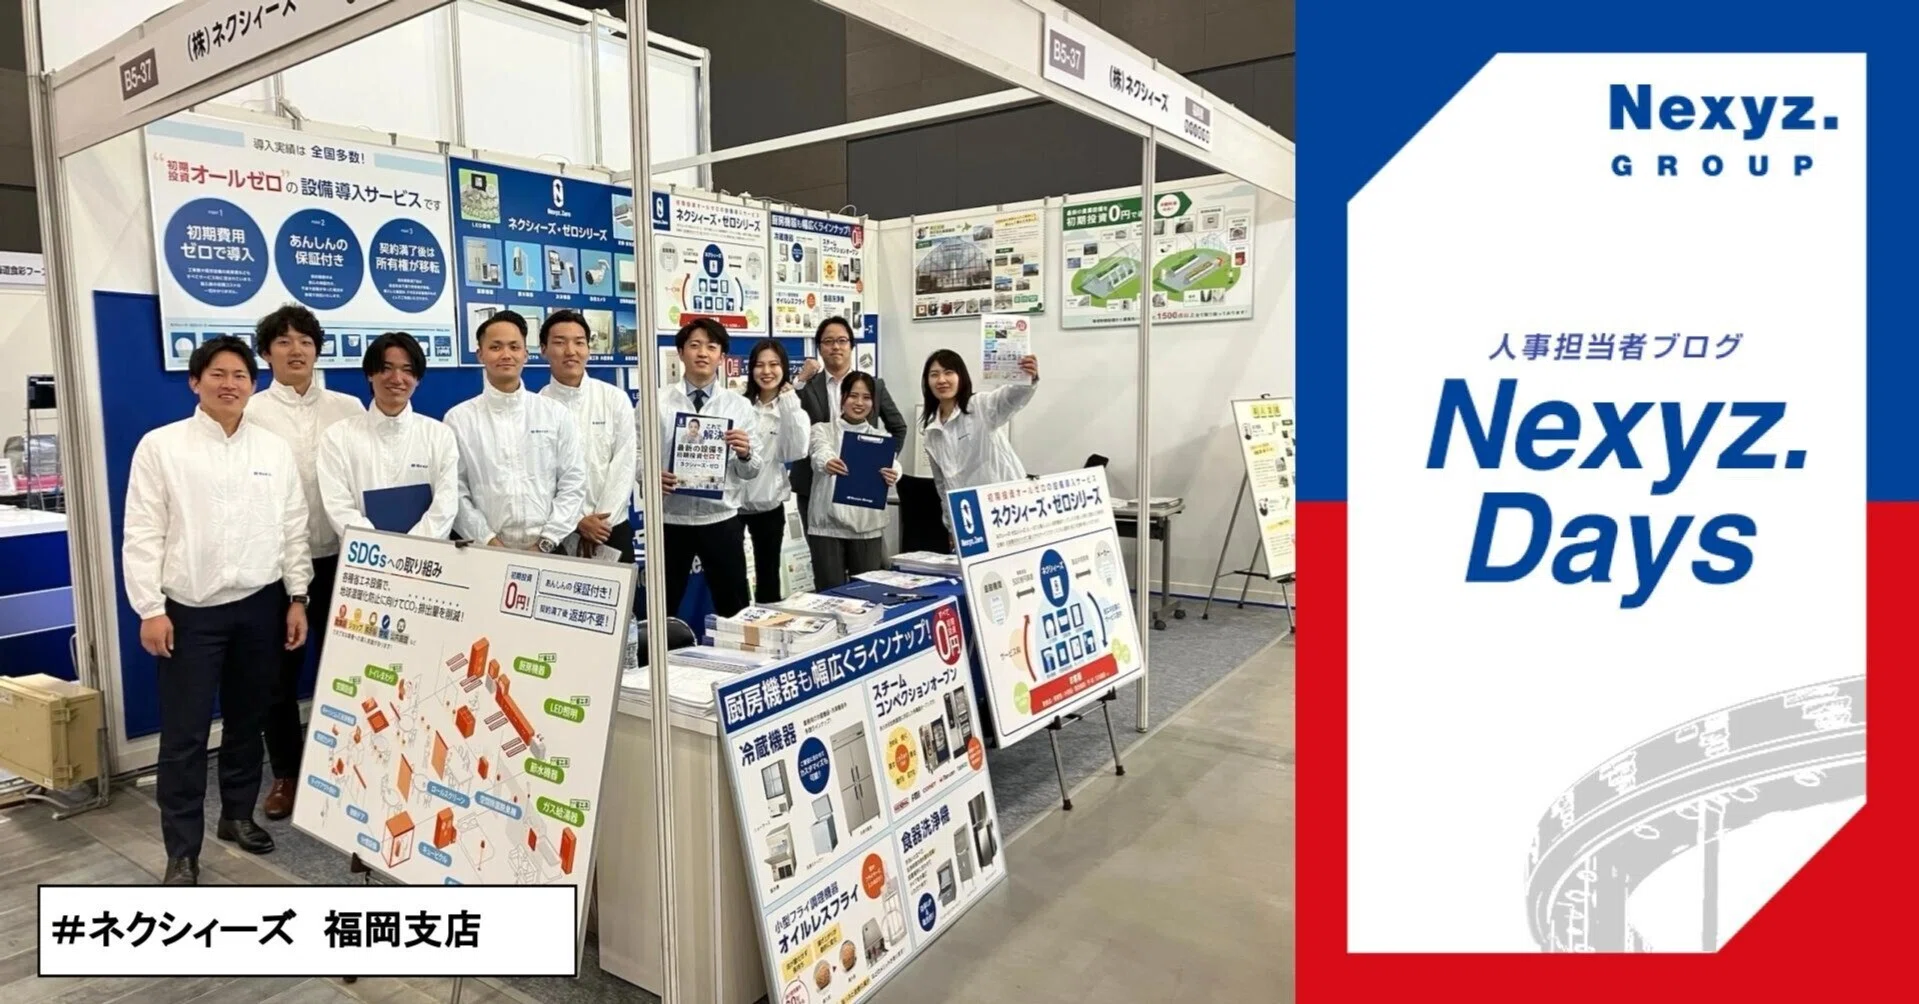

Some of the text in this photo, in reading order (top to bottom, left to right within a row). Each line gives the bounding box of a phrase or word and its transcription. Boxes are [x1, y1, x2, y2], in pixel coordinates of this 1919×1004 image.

[1053, 40, 1082, 70] B5-37
[124, 57, 152, 91] B5-37
[1109, 65, 1169, 112] (株)ネクシィーズ
[253, 138, 306, 156] 導入実績は
[311, 145, 365, 164] 全国多数!
[508, 217, 607, 241] ネクシィーズ・ゼロシリーズ
[676, 208, 761, 232] ネクシィーズ・ゼロシリーズ
[186, 225, 245, 244] 初期費用
[289, 234, 348, 251] あんしんの
[180, 242, 255, 262] ゼロで導入
[295, 251, 344, 267] 保証付き
[379, 242, 435, 257] 契約満了後は
[376, 256, 440, 274] 所有権が移転
[703, 430, 724, 440] 解決
[677, 444, 723, 453] 最新の設備を
[991, 487, 1103, 528] ネクシィーズ・ゼロシリーズ
[347, 541, 443, 578] SDGsへの取り組み
[505, 582, 531, 611] 0円!
[545, 579, 613, 599] あんしんの保証付き!
[540, 603, 609, 627] 契約満了後返却不要!
[726, 620, 931, 725] 厨房機器も幅広くラインナップ!
[872, 674, 907, 700] スチーム
[876, 668, 957, 718] コンベクションオーブン
[550, 702, 579, 720] LED照明
[739, 722, 797, 767] 冷蔵機器
[901, 804, 951, 854] 食器洗浄機
[778, 884, 858, 954] オイルレスフライ
